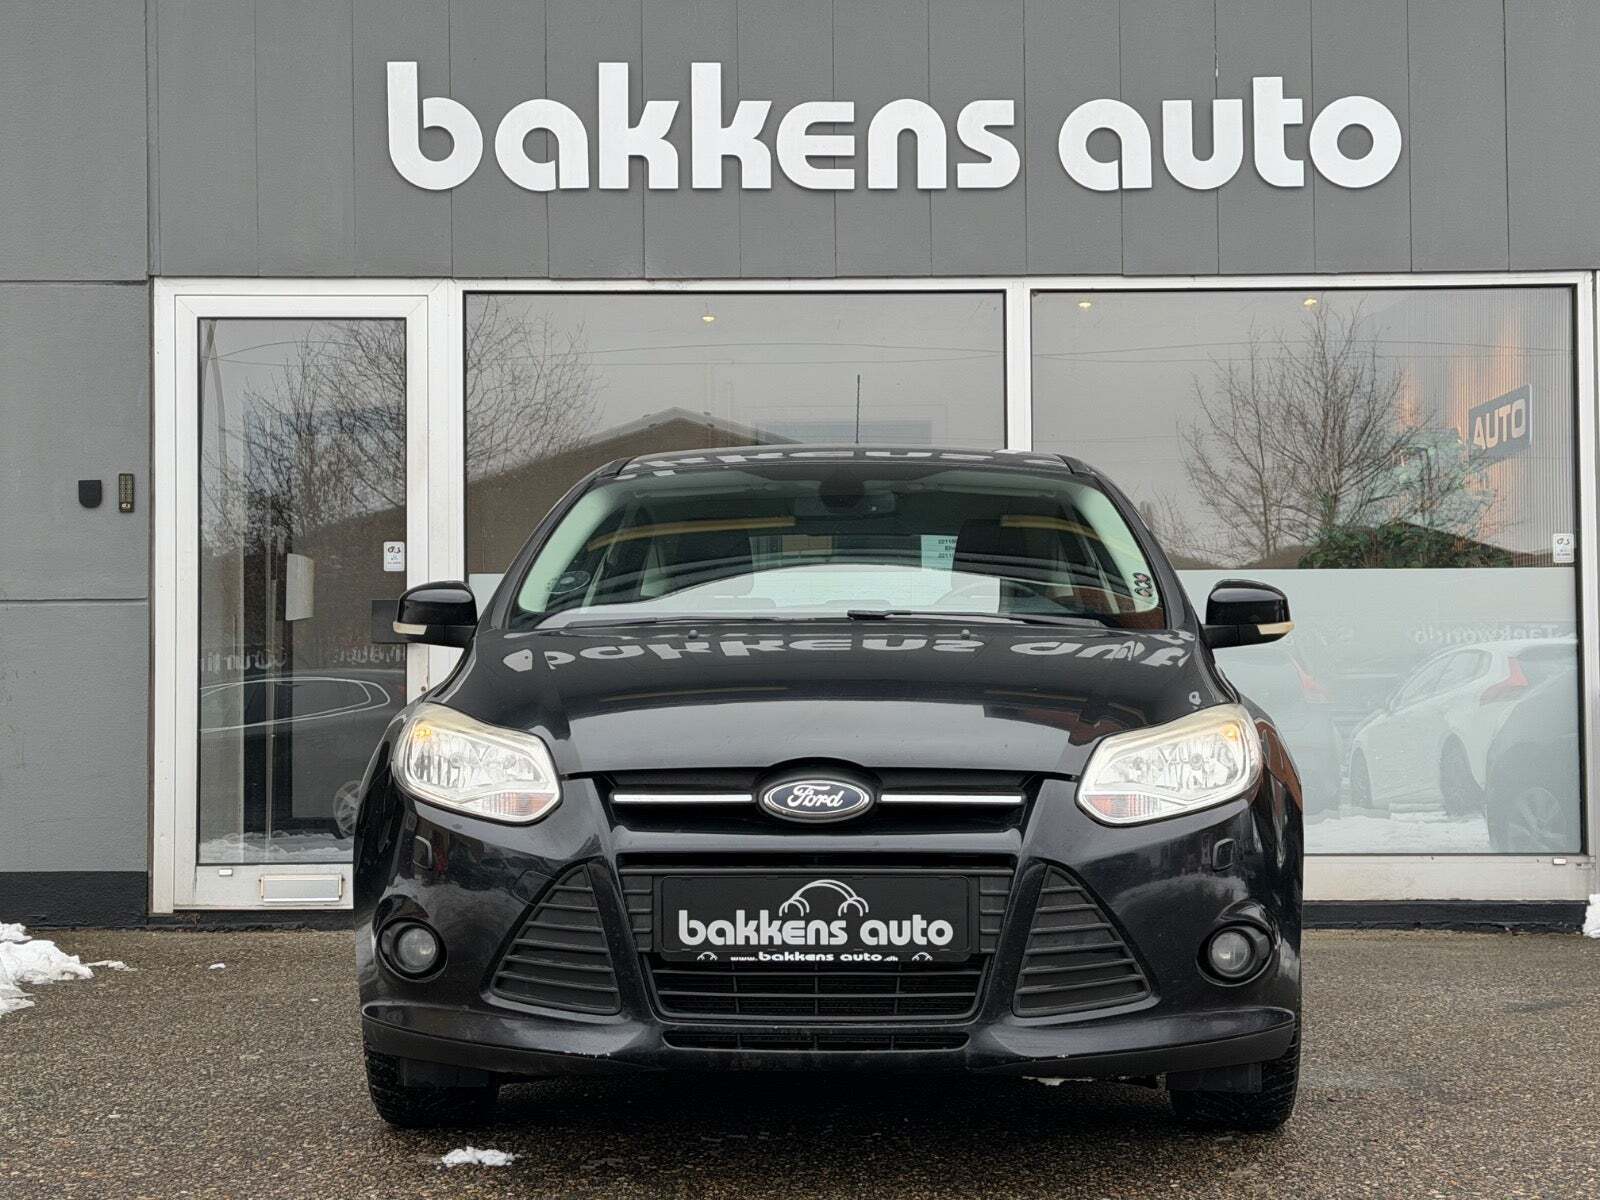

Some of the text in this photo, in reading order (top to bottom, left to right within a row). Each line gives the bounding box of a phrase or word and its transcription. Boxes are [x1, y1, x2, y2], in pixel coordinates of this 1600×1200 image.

[387, 62, 1401, 191] bakkens auto
[1472, 398, 1527, 450] AUTO
[787, 784, 844, 808] Ford
[679, 910, 953, 945] bakkens auto
[729, 951, 835, 962] www.bakkens
